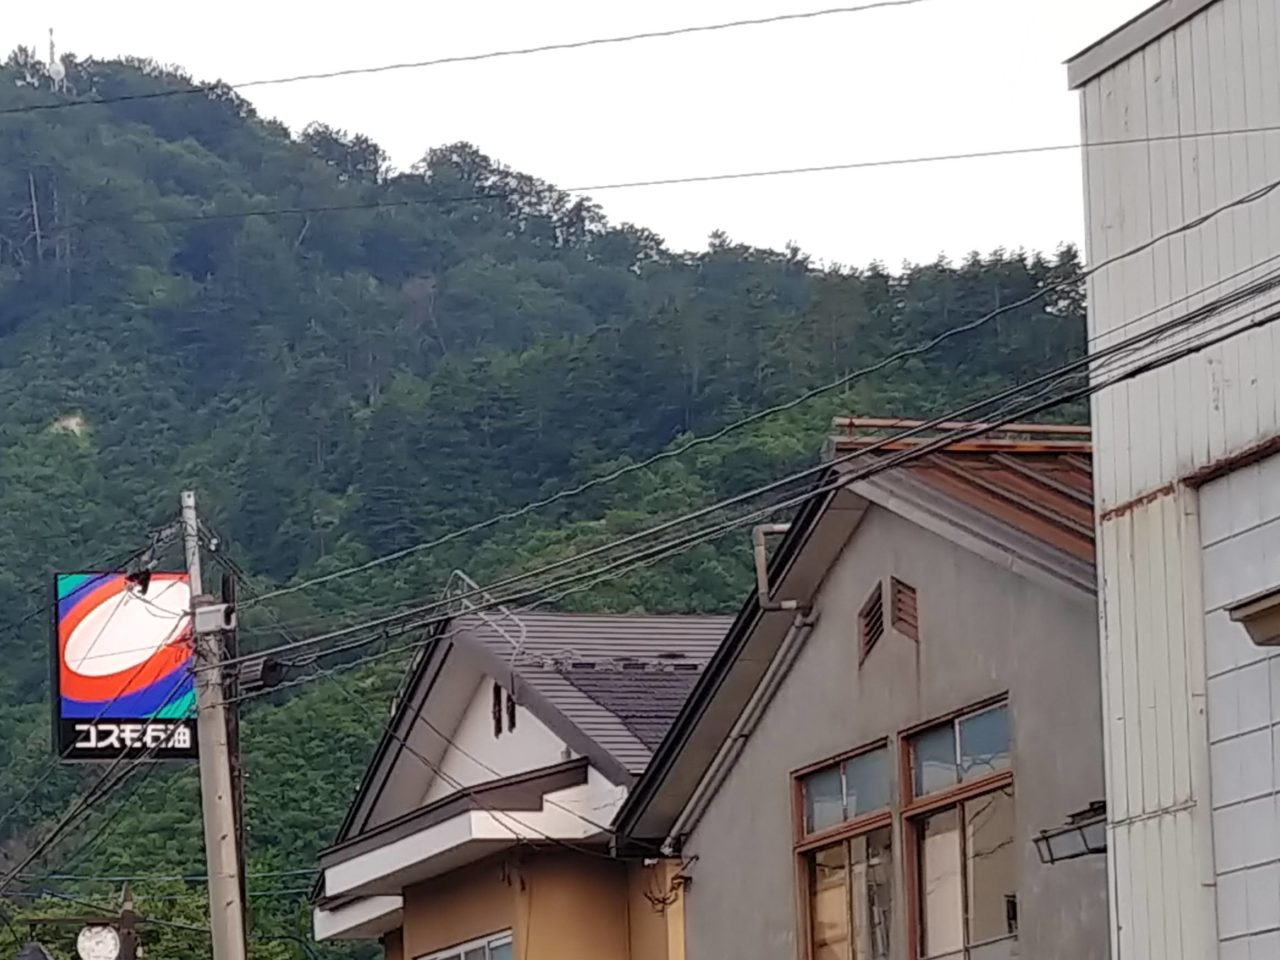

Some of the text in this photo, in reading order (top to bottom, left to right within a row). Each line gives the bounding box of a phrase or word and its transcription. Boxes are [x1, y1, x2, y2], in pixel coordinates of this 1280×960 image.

[74, 723, 191, 749] コスモ石油
